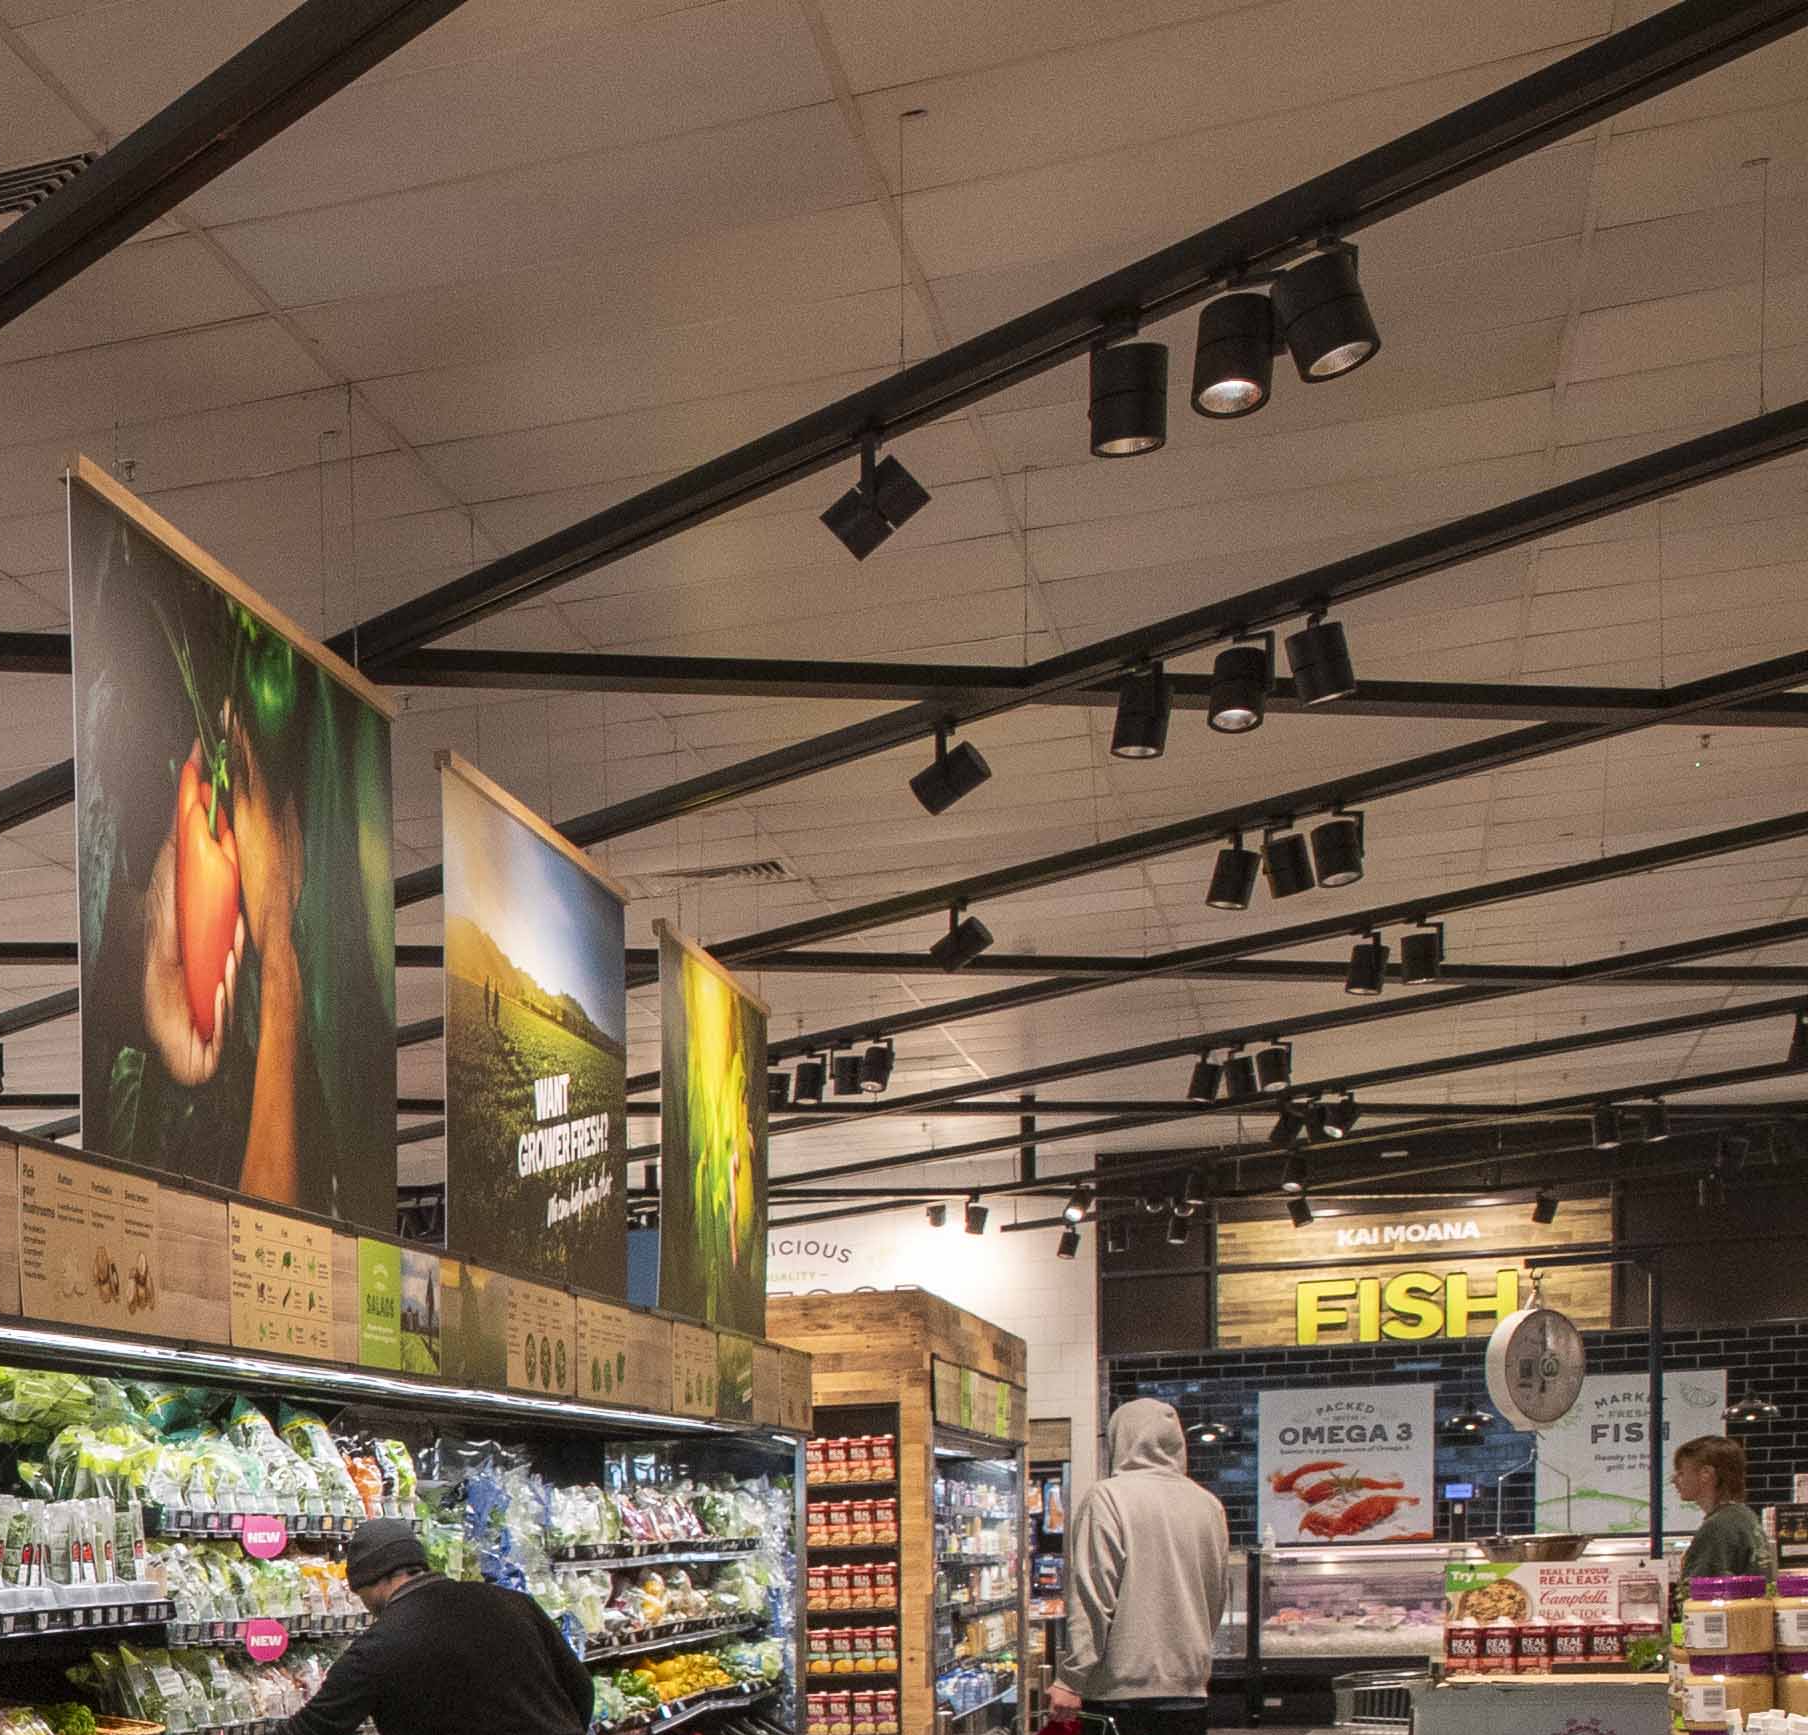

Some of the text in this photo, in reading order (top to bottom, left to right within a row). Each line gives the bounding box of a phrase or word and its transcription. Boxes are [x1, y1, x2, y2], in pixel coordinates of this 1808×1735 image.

[535, 1073, 571, 1121] WANT
[1336, 1220, 1481, 1248] KAI MOANA
[768, 1240, 853, 1264] ICIOUS
[1295, 1267, 1520, 1346] FISH
[1278, 1422, 1413, 1446] OMEGA 3
[246, 1531, 281, 1544] NEW
[1539, 1575, 1574, 1586] REAL
[250, 1634, 283, 1647] NEW
